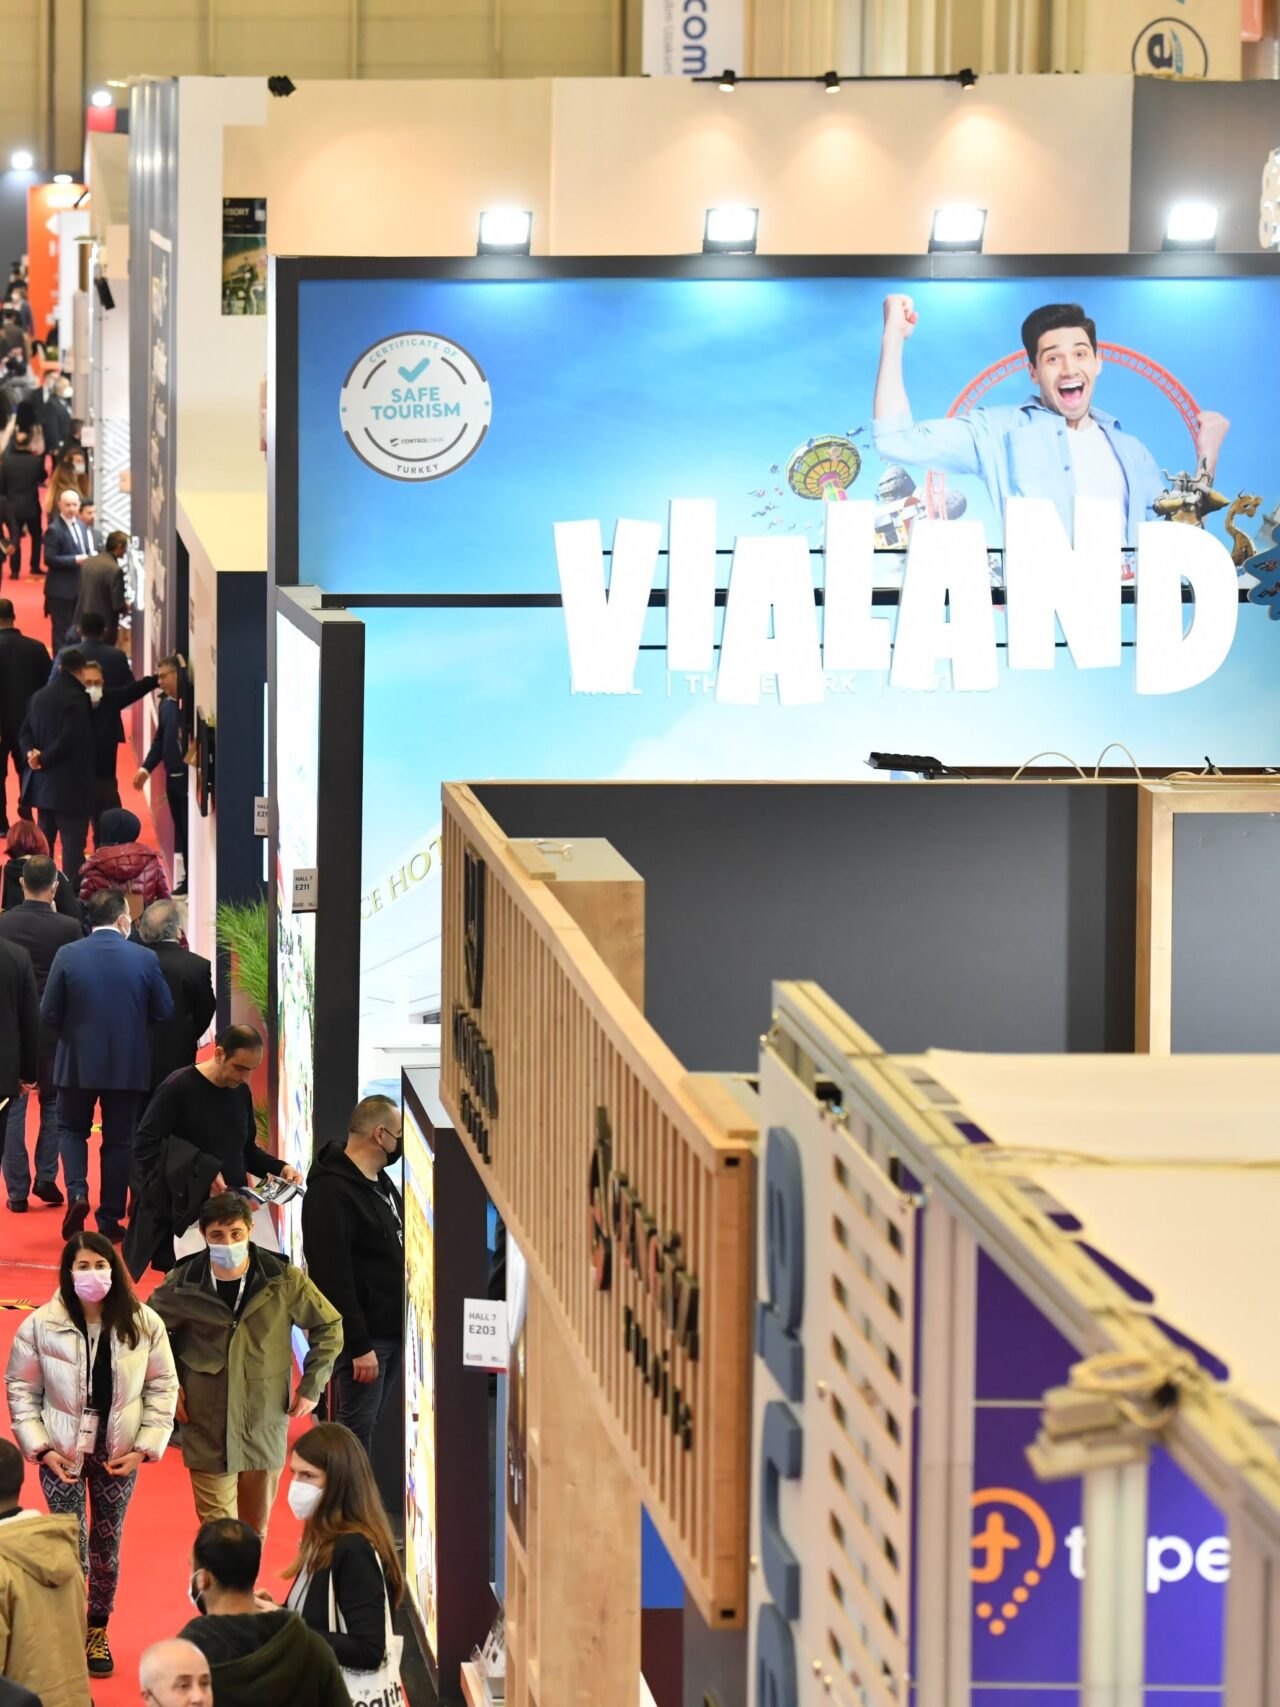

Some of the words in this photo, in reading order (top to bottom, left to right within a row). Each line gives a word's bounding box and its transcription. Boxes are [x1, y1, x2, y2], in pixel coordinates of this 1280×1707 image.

[369, 338, 439, 364] CERTIFICATE
[443, 346, 458, 358] OF
[391, 387, 440, 404] SAFE
[371, 402, 461, 420] TOURISM
[396, 463, 439, 474] TURKEY
[553, 497, 1239, 704] VIALAND
[295, 883, 310, 891] E211
[468, 1312, 489, 1321] HALL
[491, 1313, 497, 1321] 7
[468, 1324, 496, 1336] E203
